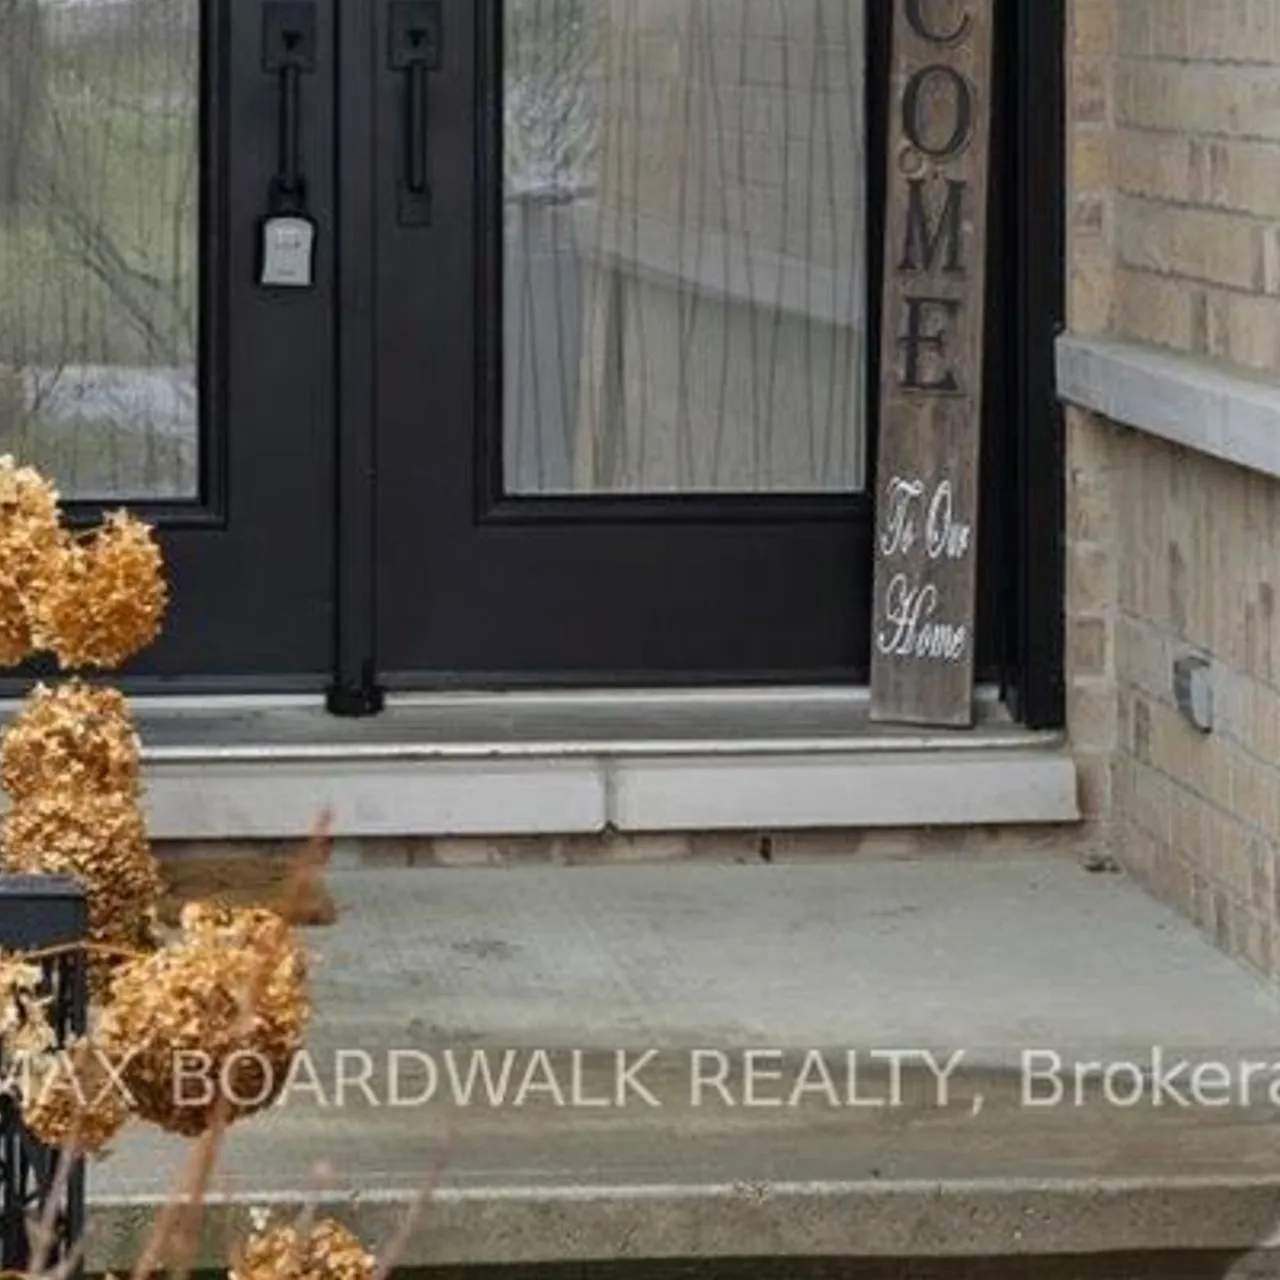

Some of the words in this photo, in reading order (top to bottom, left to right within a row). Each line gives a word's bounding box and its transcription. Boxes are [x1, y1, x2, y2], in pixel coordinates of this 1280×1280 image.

[881, 477, 922, 555] To
[926, 481, 970, 558] Our
[878, 574, 966, 658] Home
